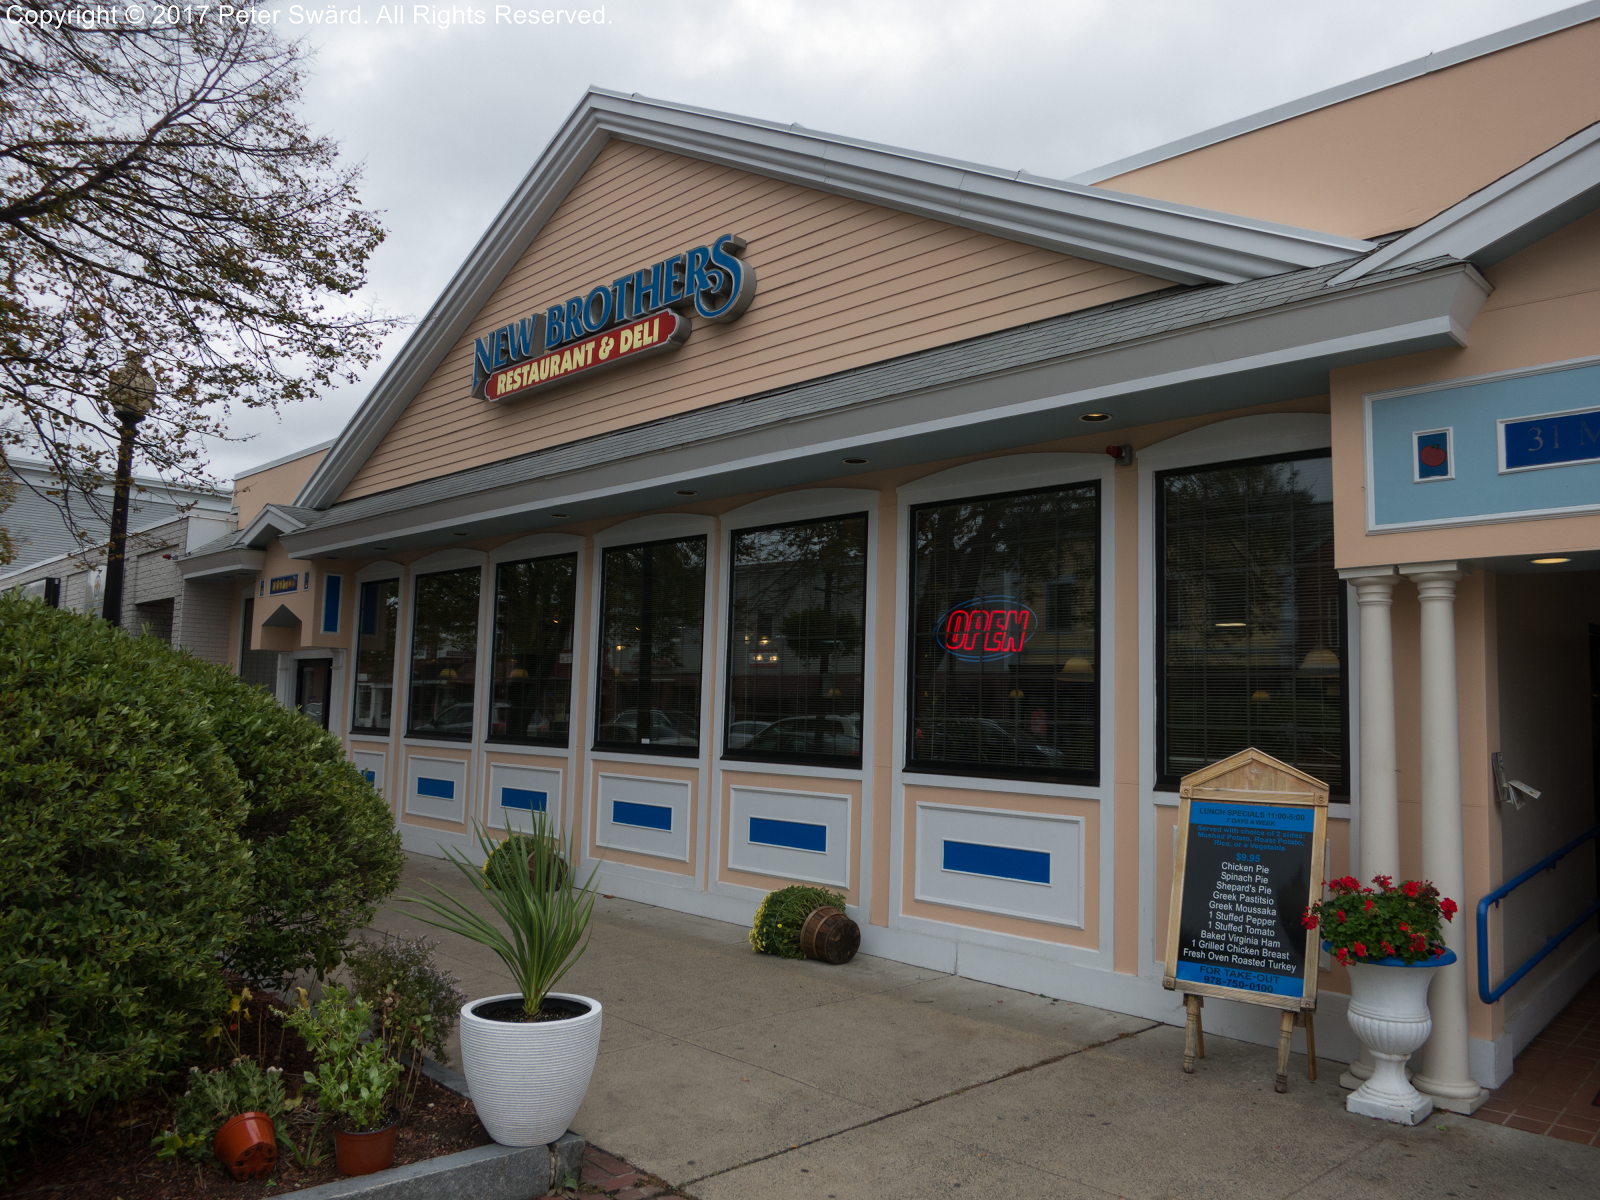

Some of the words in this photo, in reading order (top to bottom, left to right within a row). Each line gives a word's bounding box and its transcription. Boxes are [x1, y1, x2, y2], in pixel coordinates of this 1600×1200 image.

[471, 312, 543, 397] NEW
[545, 233, 750, 321] BROTHERS
[496, 341, 596, 396] RESTAURANT
[598, 335, 615, 361] &
[619, 317, 660, 355] DELI
[1527, 424, 1561, 452] 31
[946, 609, 1030, 652] OPEN
[1199, 808, 1225, 816] LUNCH
[1227, 809, 1265, 818] SPECIALS
[1197, 825, 1222, 833] Served
[1198, 832, 1225, 840] Mashed
[1227, 834, 1252, 842] Potato,
[1278, 838, 1304, 846] Potato,
[1249, 842, 1286, 851] Vegetable
[1236, 852, 1260, 862] $9.95
[1221, 862, 1253, 872] Chicken
[1256, 864, 1270, 874] Pie
[1221, 872, 1252, 883] Spinach
[1255, 875, 1268, 884] Pie
[1216, 881, 1256, 893] Shepard's
[1258, 885, 1272, 894] Pie
[1213, 890, 1236, 901] Greek
[1239, 894, 1274, 905] Pastitsio
[1209, 900, 1233, 911] Greek
[1235, 903, 1277, 916] Moussaka
[1216, 911, 1244, 922] Stuffed
[1246, 914, 1276, 926] Pepper
[1214, 921, 1243, 933] Stuffed
[1245, 925, 1275, 936] Tomato
[1200, 930, 1226, 940] Baked
[1228, 933, 1258, 945] Virginia
[1261, 938, 1280, 948] Ham
[1198, 940, 1224, 951] Grilled
[1226, 944, 1260, 956] Chicken
[1262, 948, 1290, 960] Breast
[1183, 948, 1206, 959] Fresh
[1208, 952, 1229, 962] Oven
[1232, 955, 1266, 967] Roasted
[1268, 959, 1296, 973] Turkey
[1200, 965, 1220, 976] FOR
[1224, 968, 1280, 984] TAKE-OUT
[1204, 975, 1274, 993] 978-750-0100
